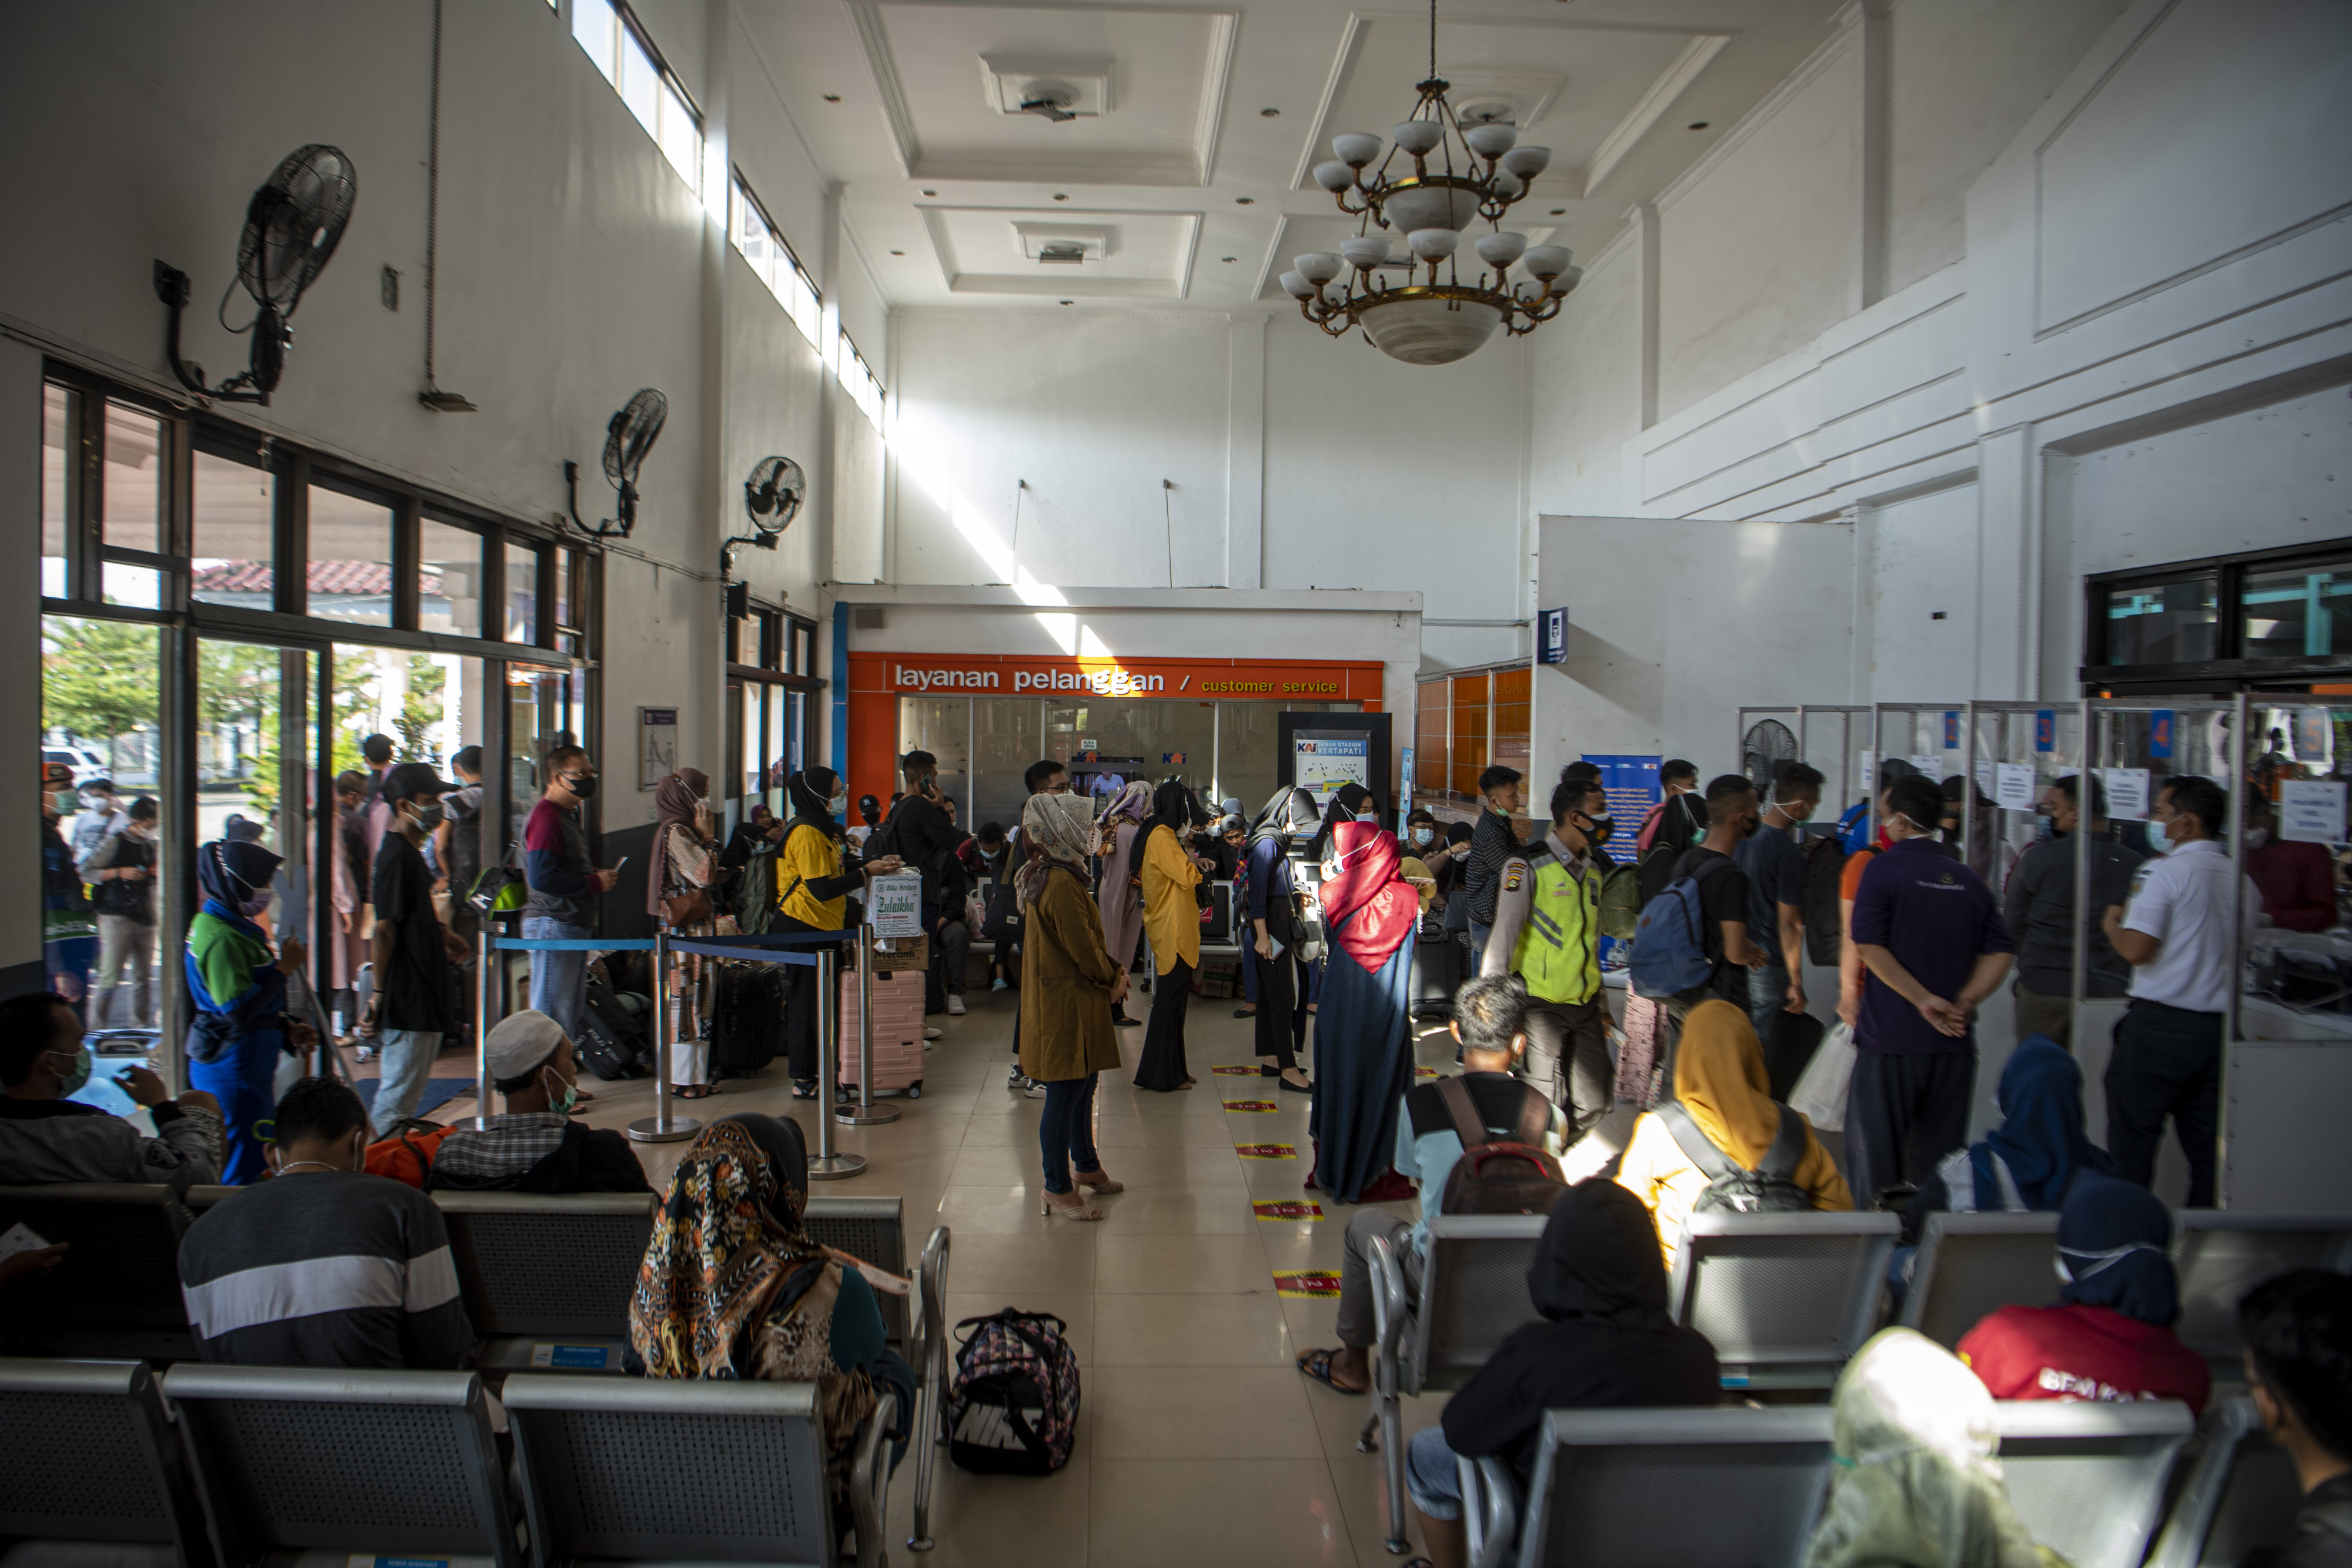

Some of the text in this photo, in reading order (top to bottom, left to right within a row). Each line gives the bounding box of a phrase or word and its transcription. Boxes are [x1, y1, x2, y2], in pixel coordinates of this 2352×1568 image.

[896, 665, 999, 691] layanan
[1015, 668, 1165, 696] pelanggan
[1202, 680, 1275, 692] customer
[1282, 680, 1338, 693] service
[1946, 718, 1957, 741] 2
[2039, 718, 2052, 744] 3
[2153, 718, 2170, 748] 4
[2304, 718, 2322, 752] 5
[1077, 751, 1101, 763] KAI
[1162, 753, 1187, 764] KAI
[1297, 743, 1317, 753] KAI
[877, 897, 914, 913] Zulaikha
[874, 950, 915, 959] Meranti
[587, 1028, 623, 1064] POLO KING
[954, 1402, 1043, 1452] NIKE
